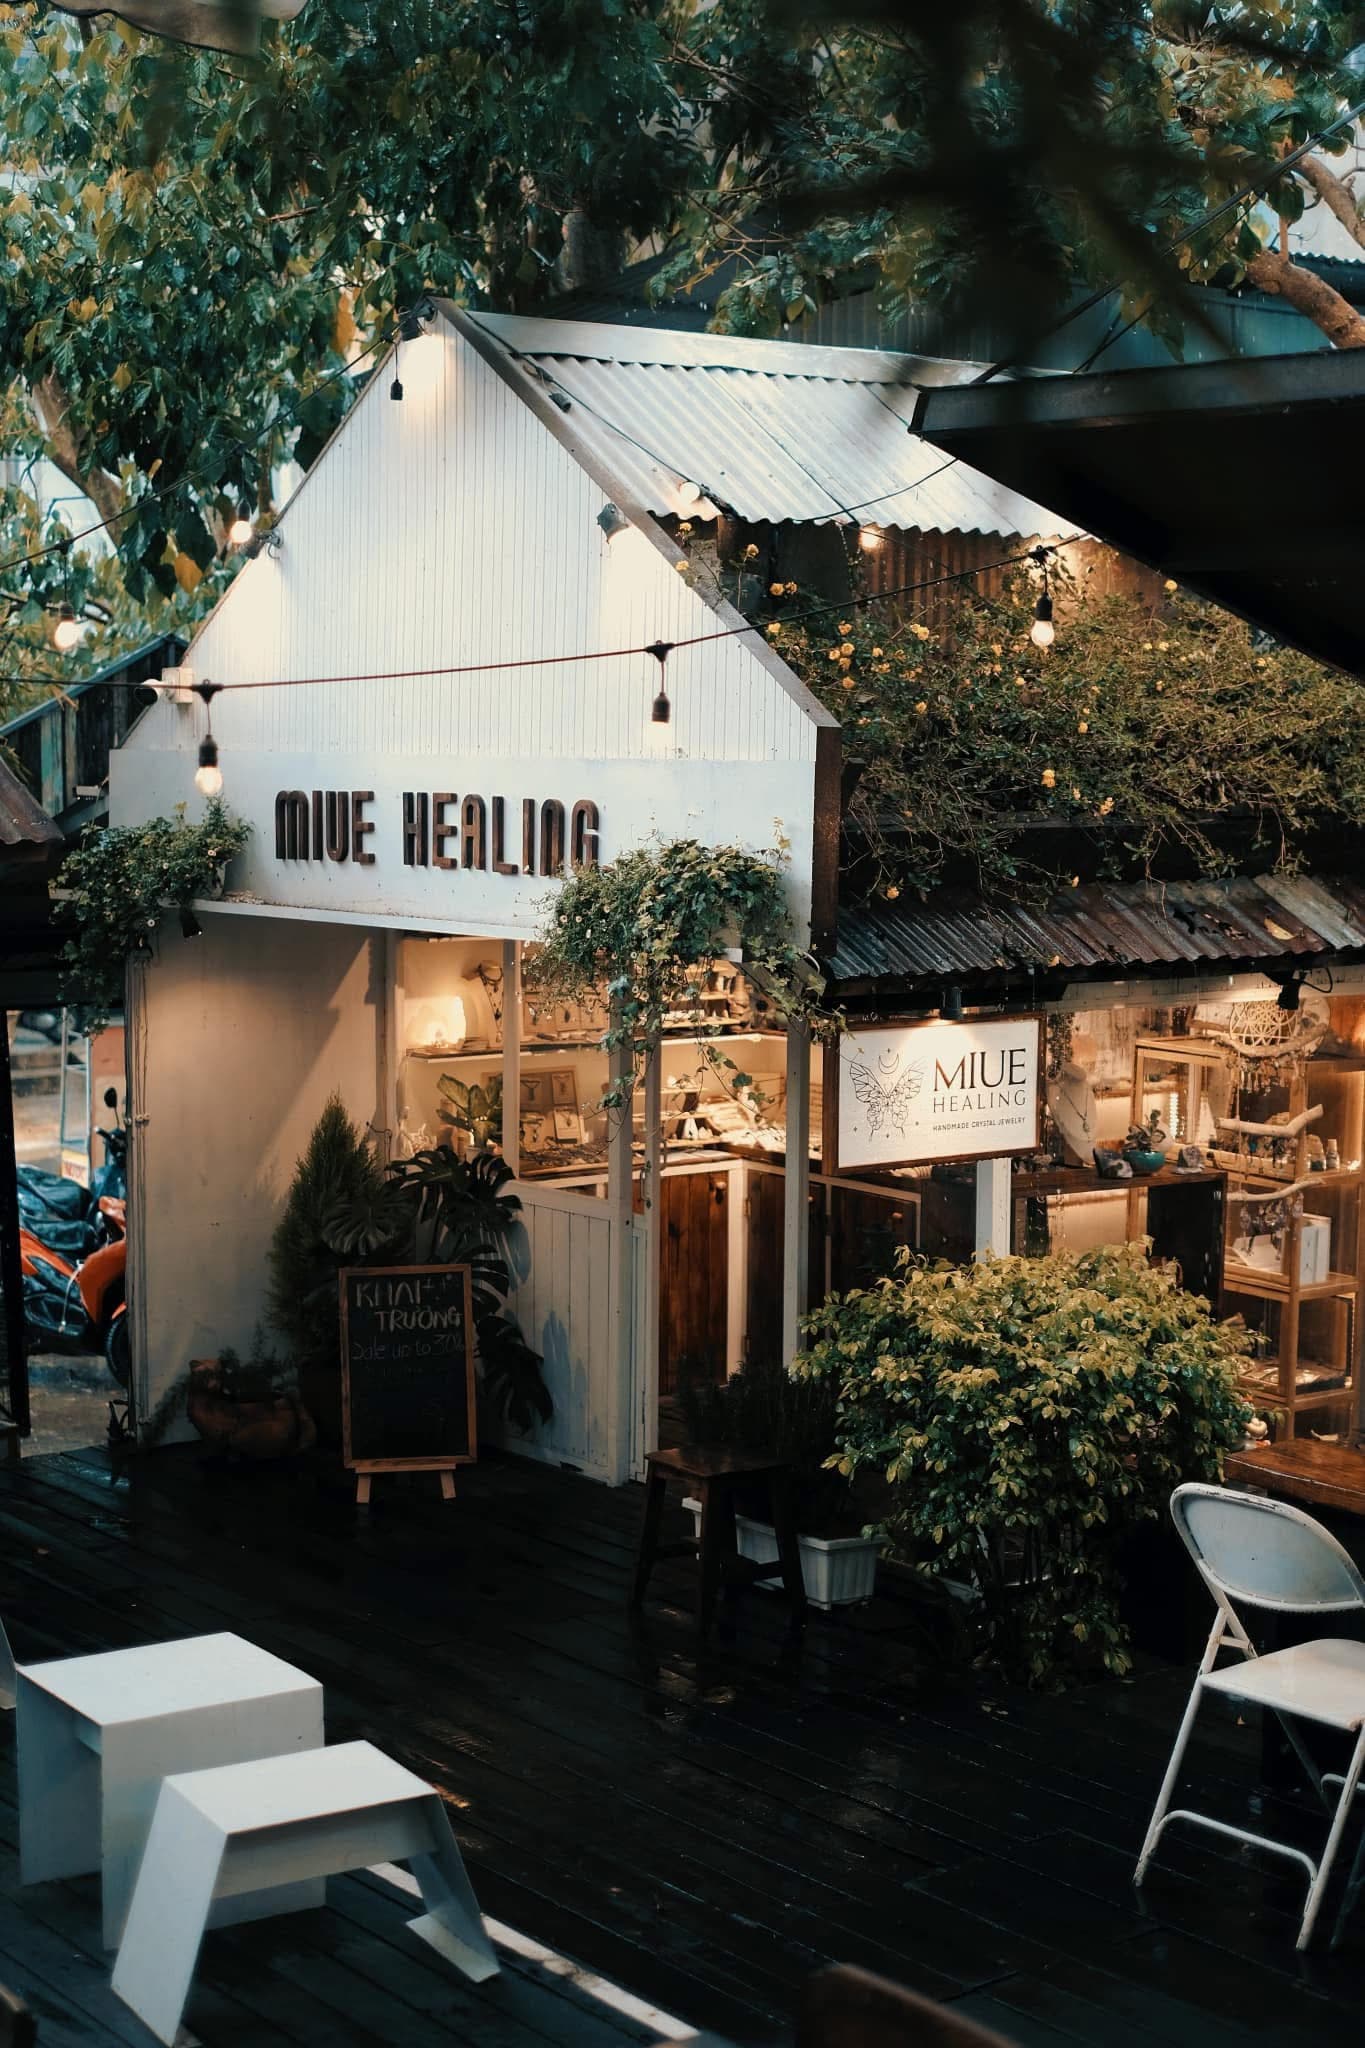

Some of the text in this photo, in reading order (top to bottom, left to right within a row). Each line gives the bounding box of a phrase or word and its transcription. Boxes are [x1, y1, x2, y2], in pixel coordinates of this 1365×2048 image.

[275, 790, 599, 877] MIUE HEALING
[934, 1048, 1026, 1092] MIUE
[933, 1089, 1026, 1113] HEALING
[933, 1117, 1026, 1131] HANDMADE CRYSTAL JEWELRY
[415, 1339, 431, 1356] to
